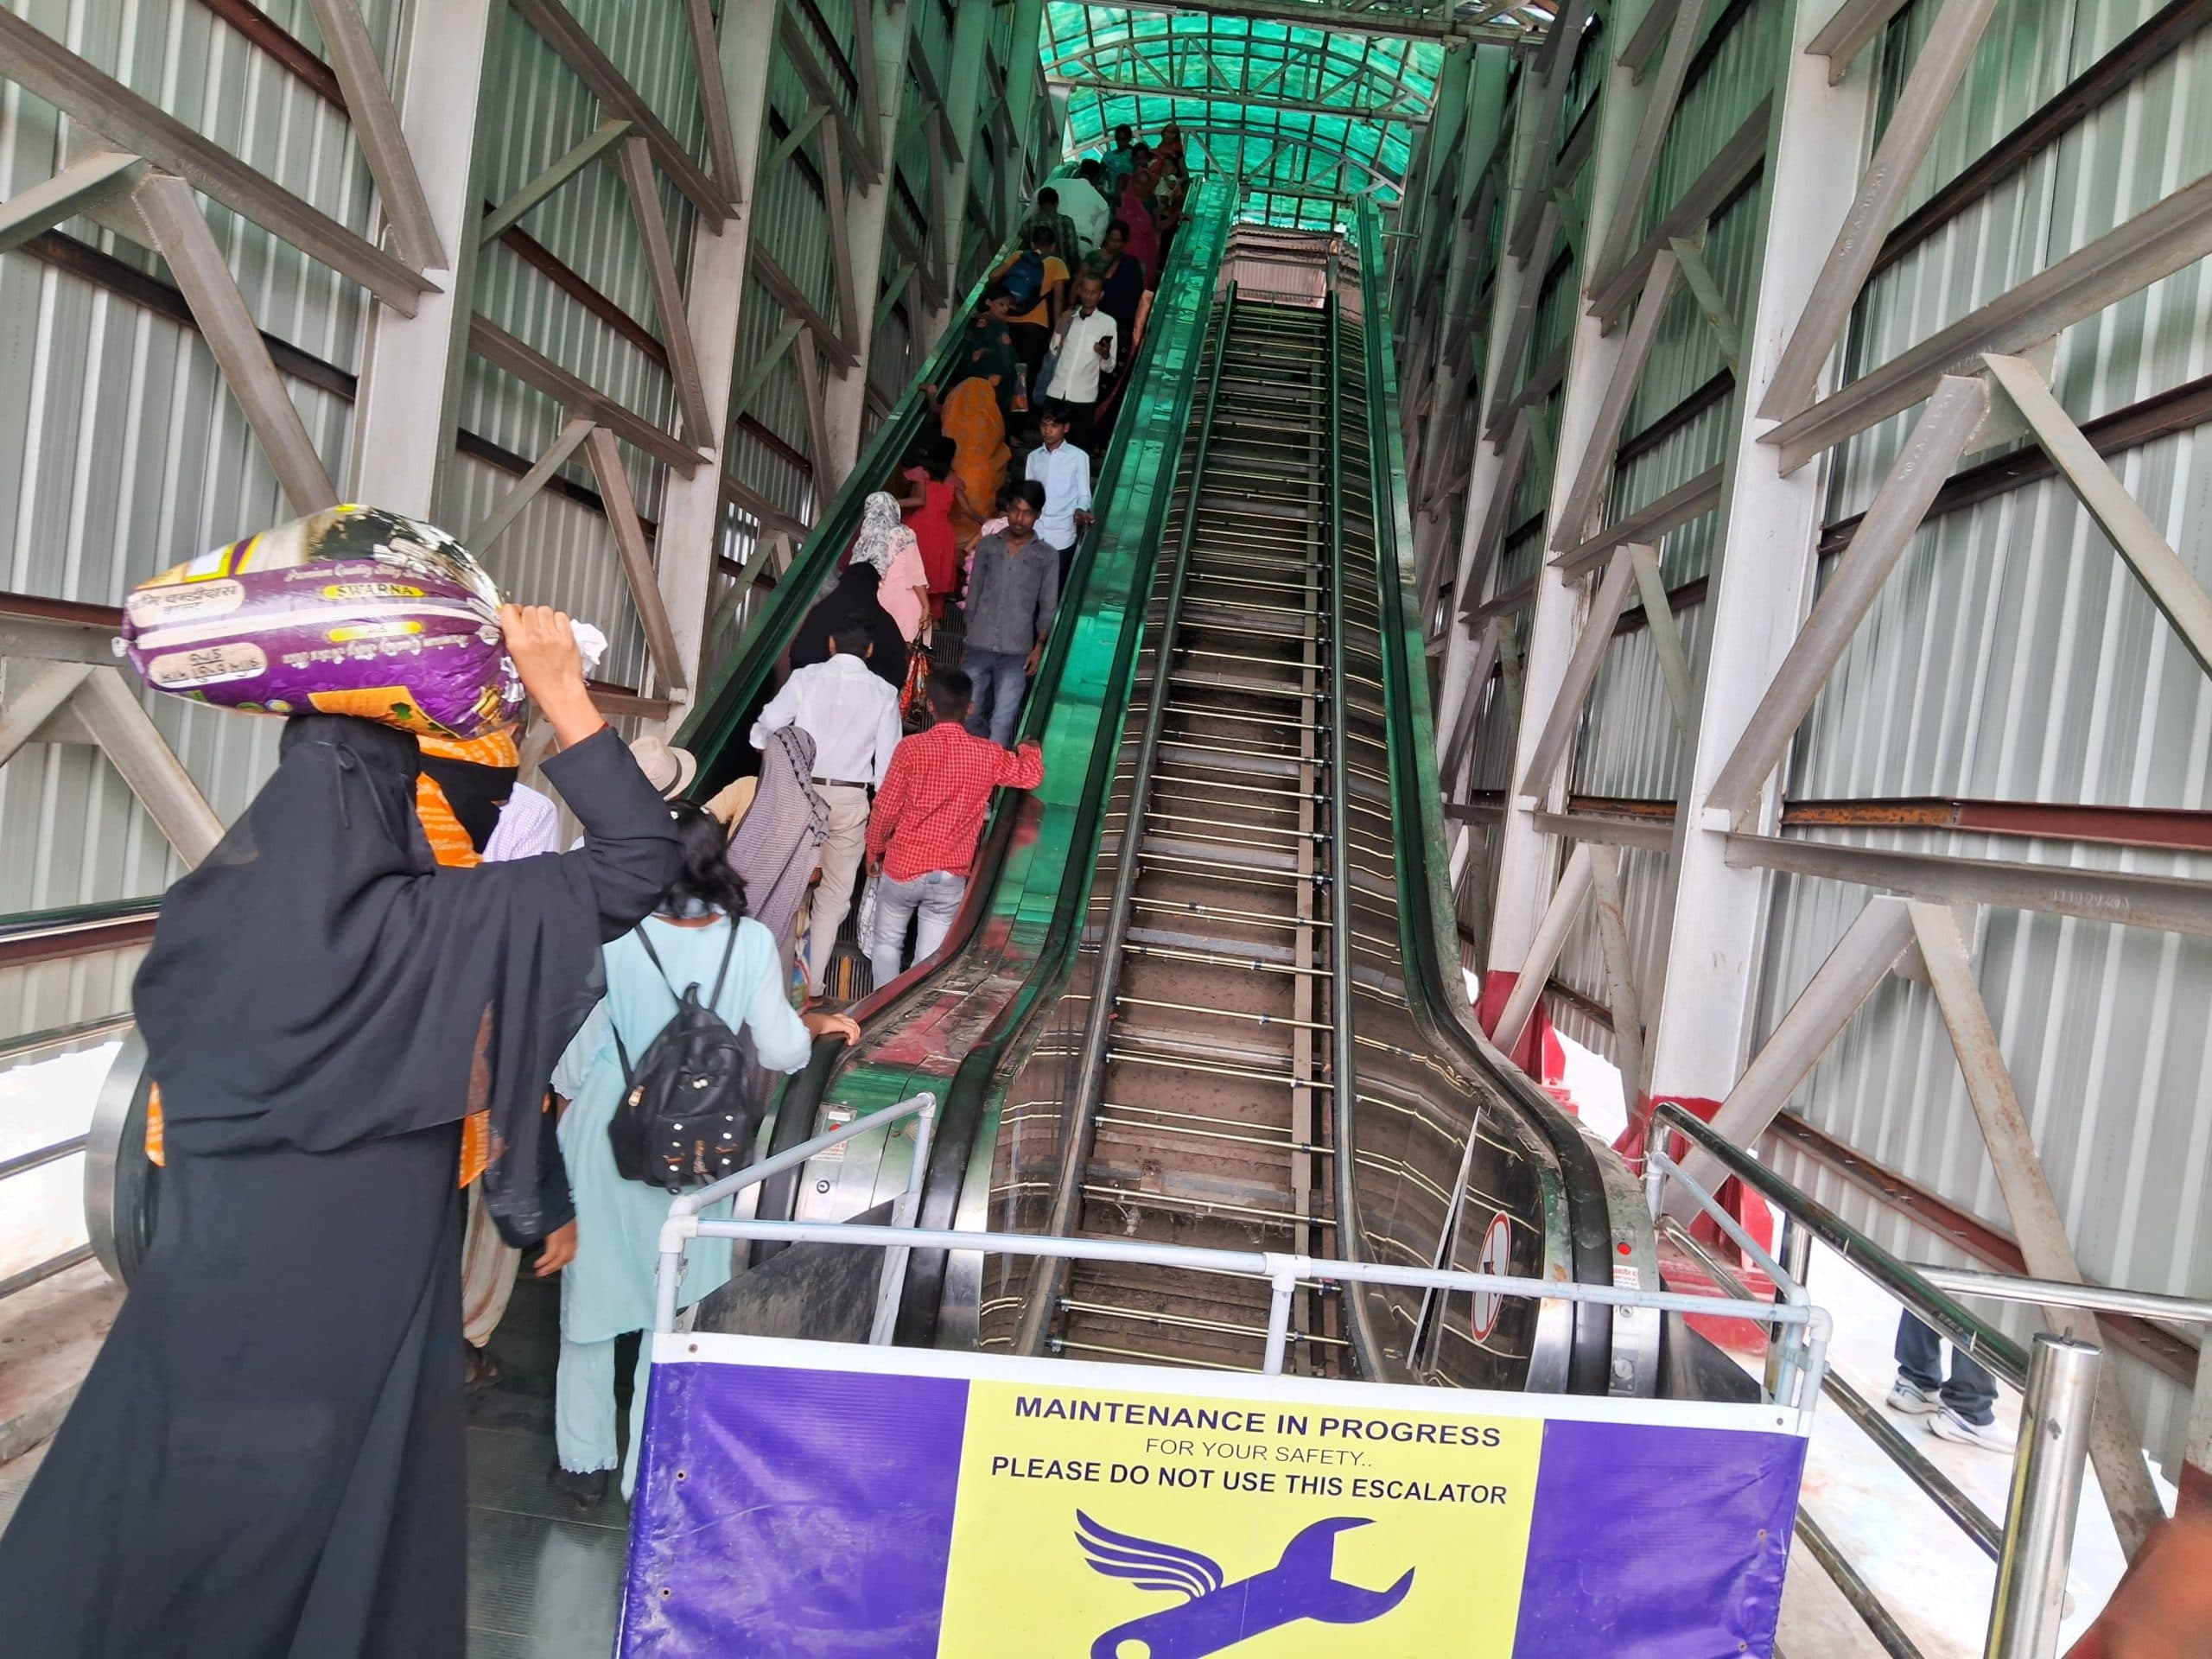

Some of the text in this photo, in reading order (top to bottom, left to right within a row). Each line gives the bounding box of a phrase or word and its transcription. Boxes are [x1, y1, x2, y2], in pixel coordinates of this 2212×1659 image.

[336, 582, 414, 597] SWARNA
[1015, 1395, 1501, 1447] MAINTENANCE IN PROGRESS
[1146, 1438, 1194, 1456] FOR
[1202, 1442, 1268, 1460] YOUR
[991, 1456, 1507, 1505] PLEASE DO NOT USE THIS ESCALATOR
